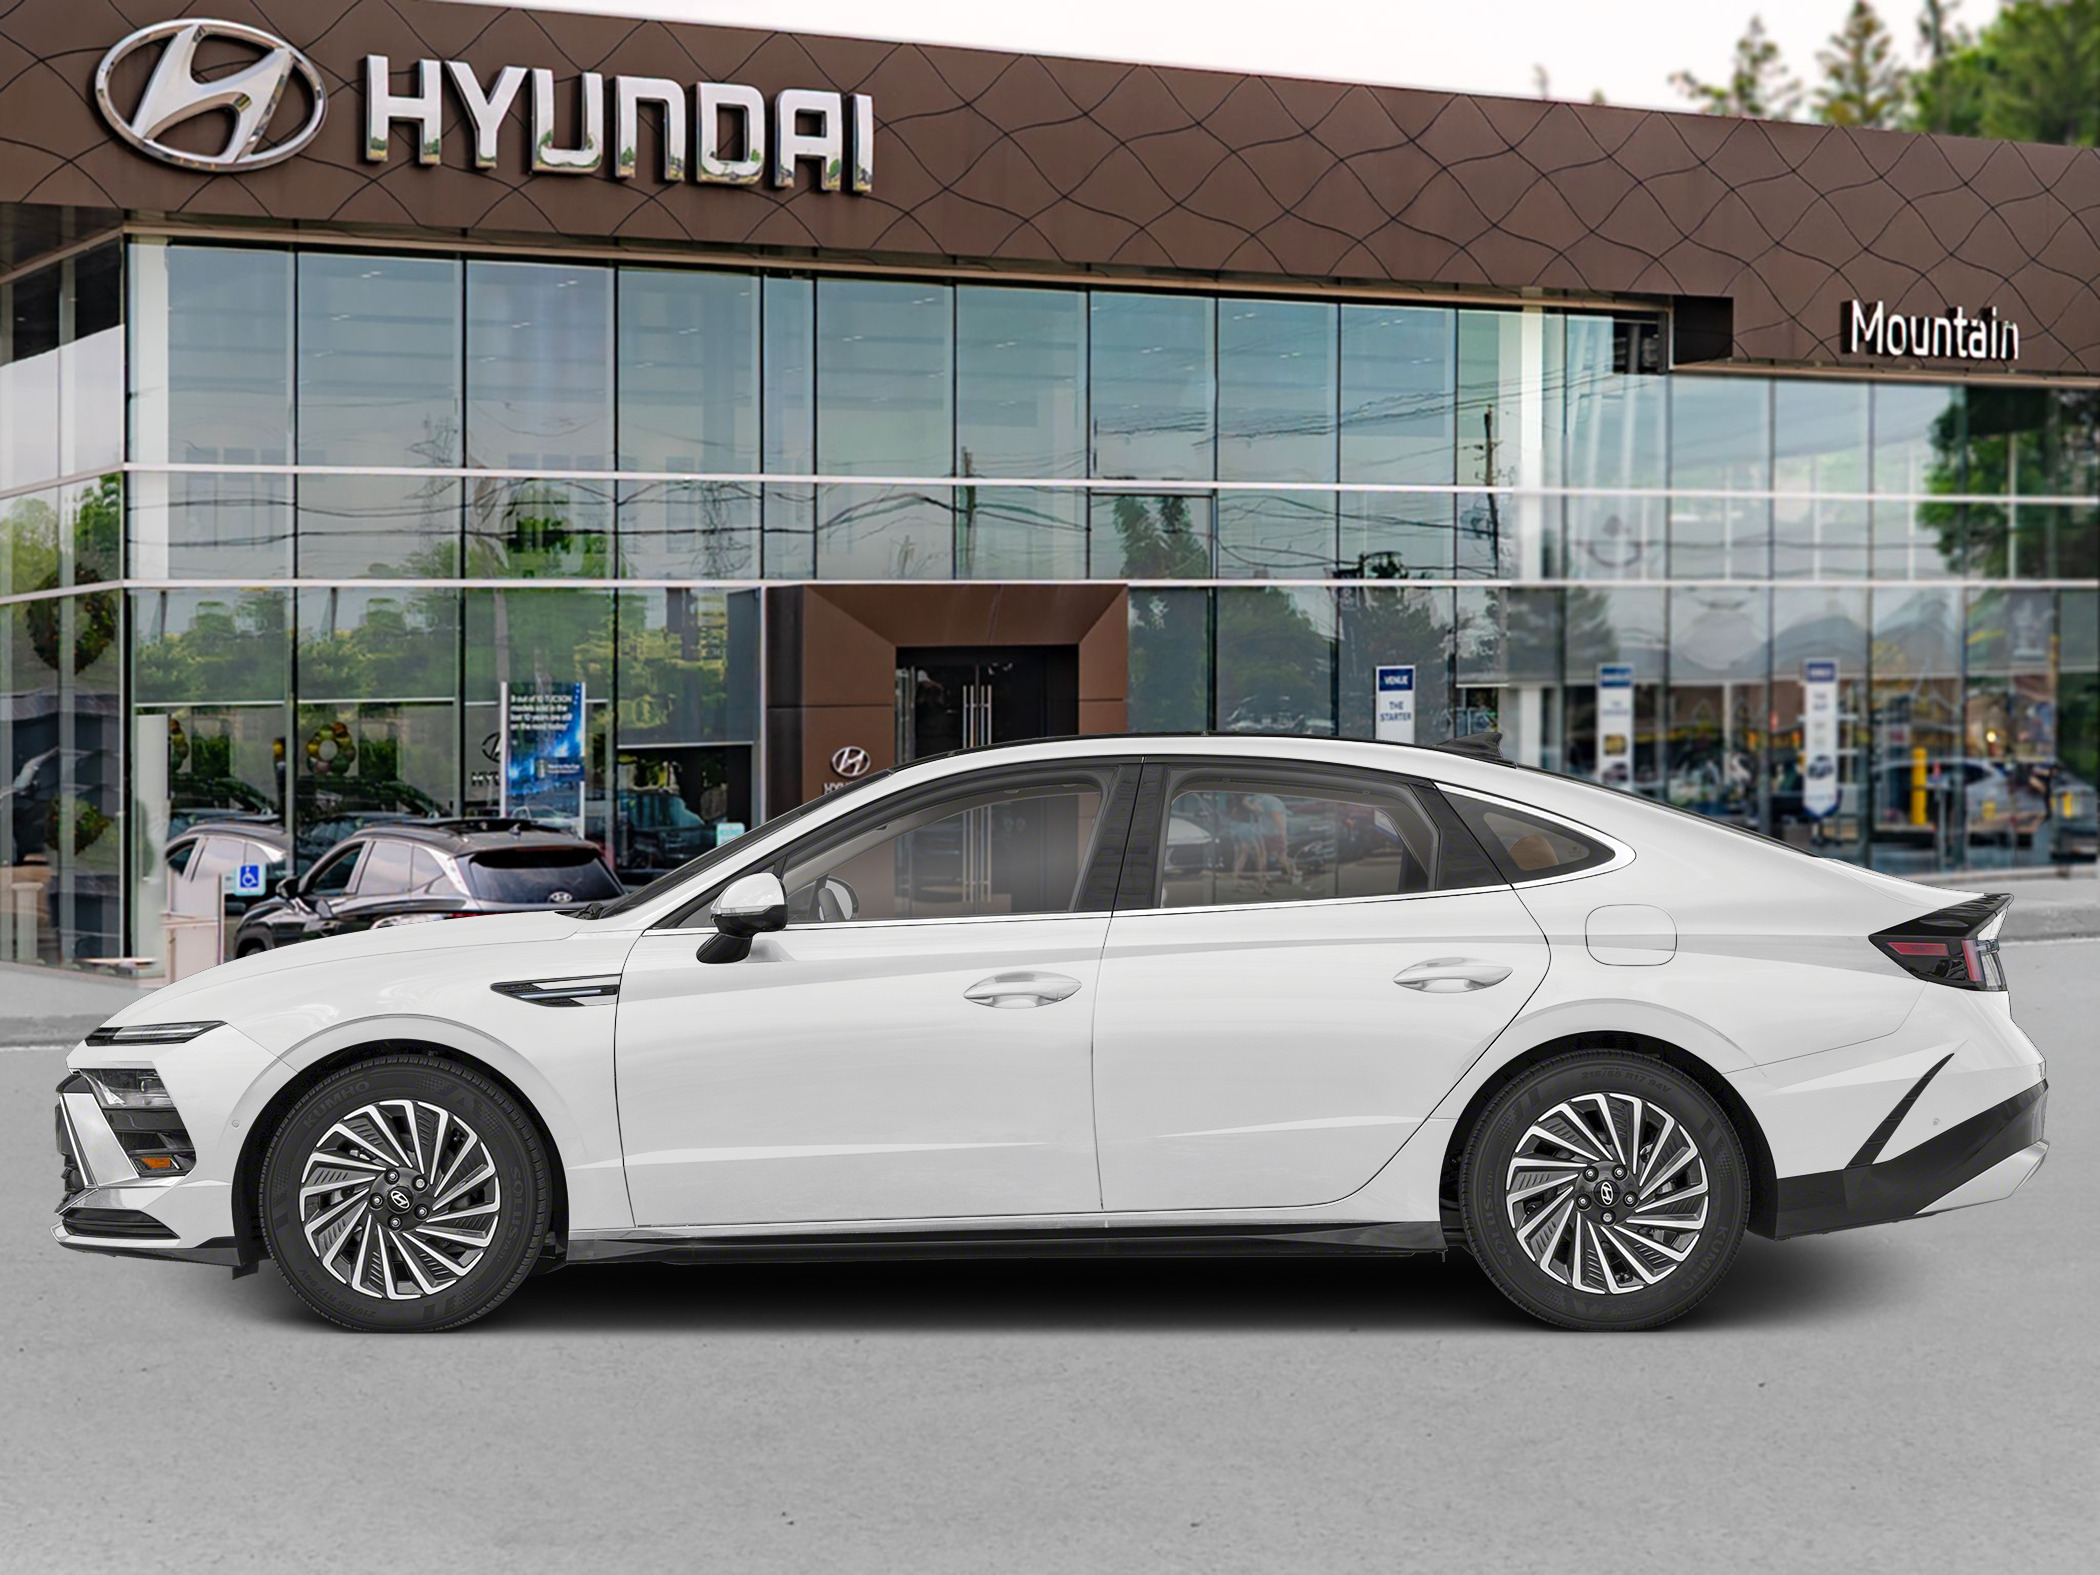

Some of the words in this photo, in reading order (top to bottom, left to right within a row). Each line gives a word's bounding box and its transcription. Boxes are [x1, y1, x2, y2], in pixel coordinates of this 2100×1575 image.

[364, 54, 874, 194] HYUNDAI
[1851, 299, 2019, 360] Mountain
[302, 1081, 370, 1128] KUMHO
[508, 1166, 524, 1239] SOLUS
[1483, 1197, 1513, 1267] SOLUS
[1680, 1226, 1729, 1291] KUMHO
